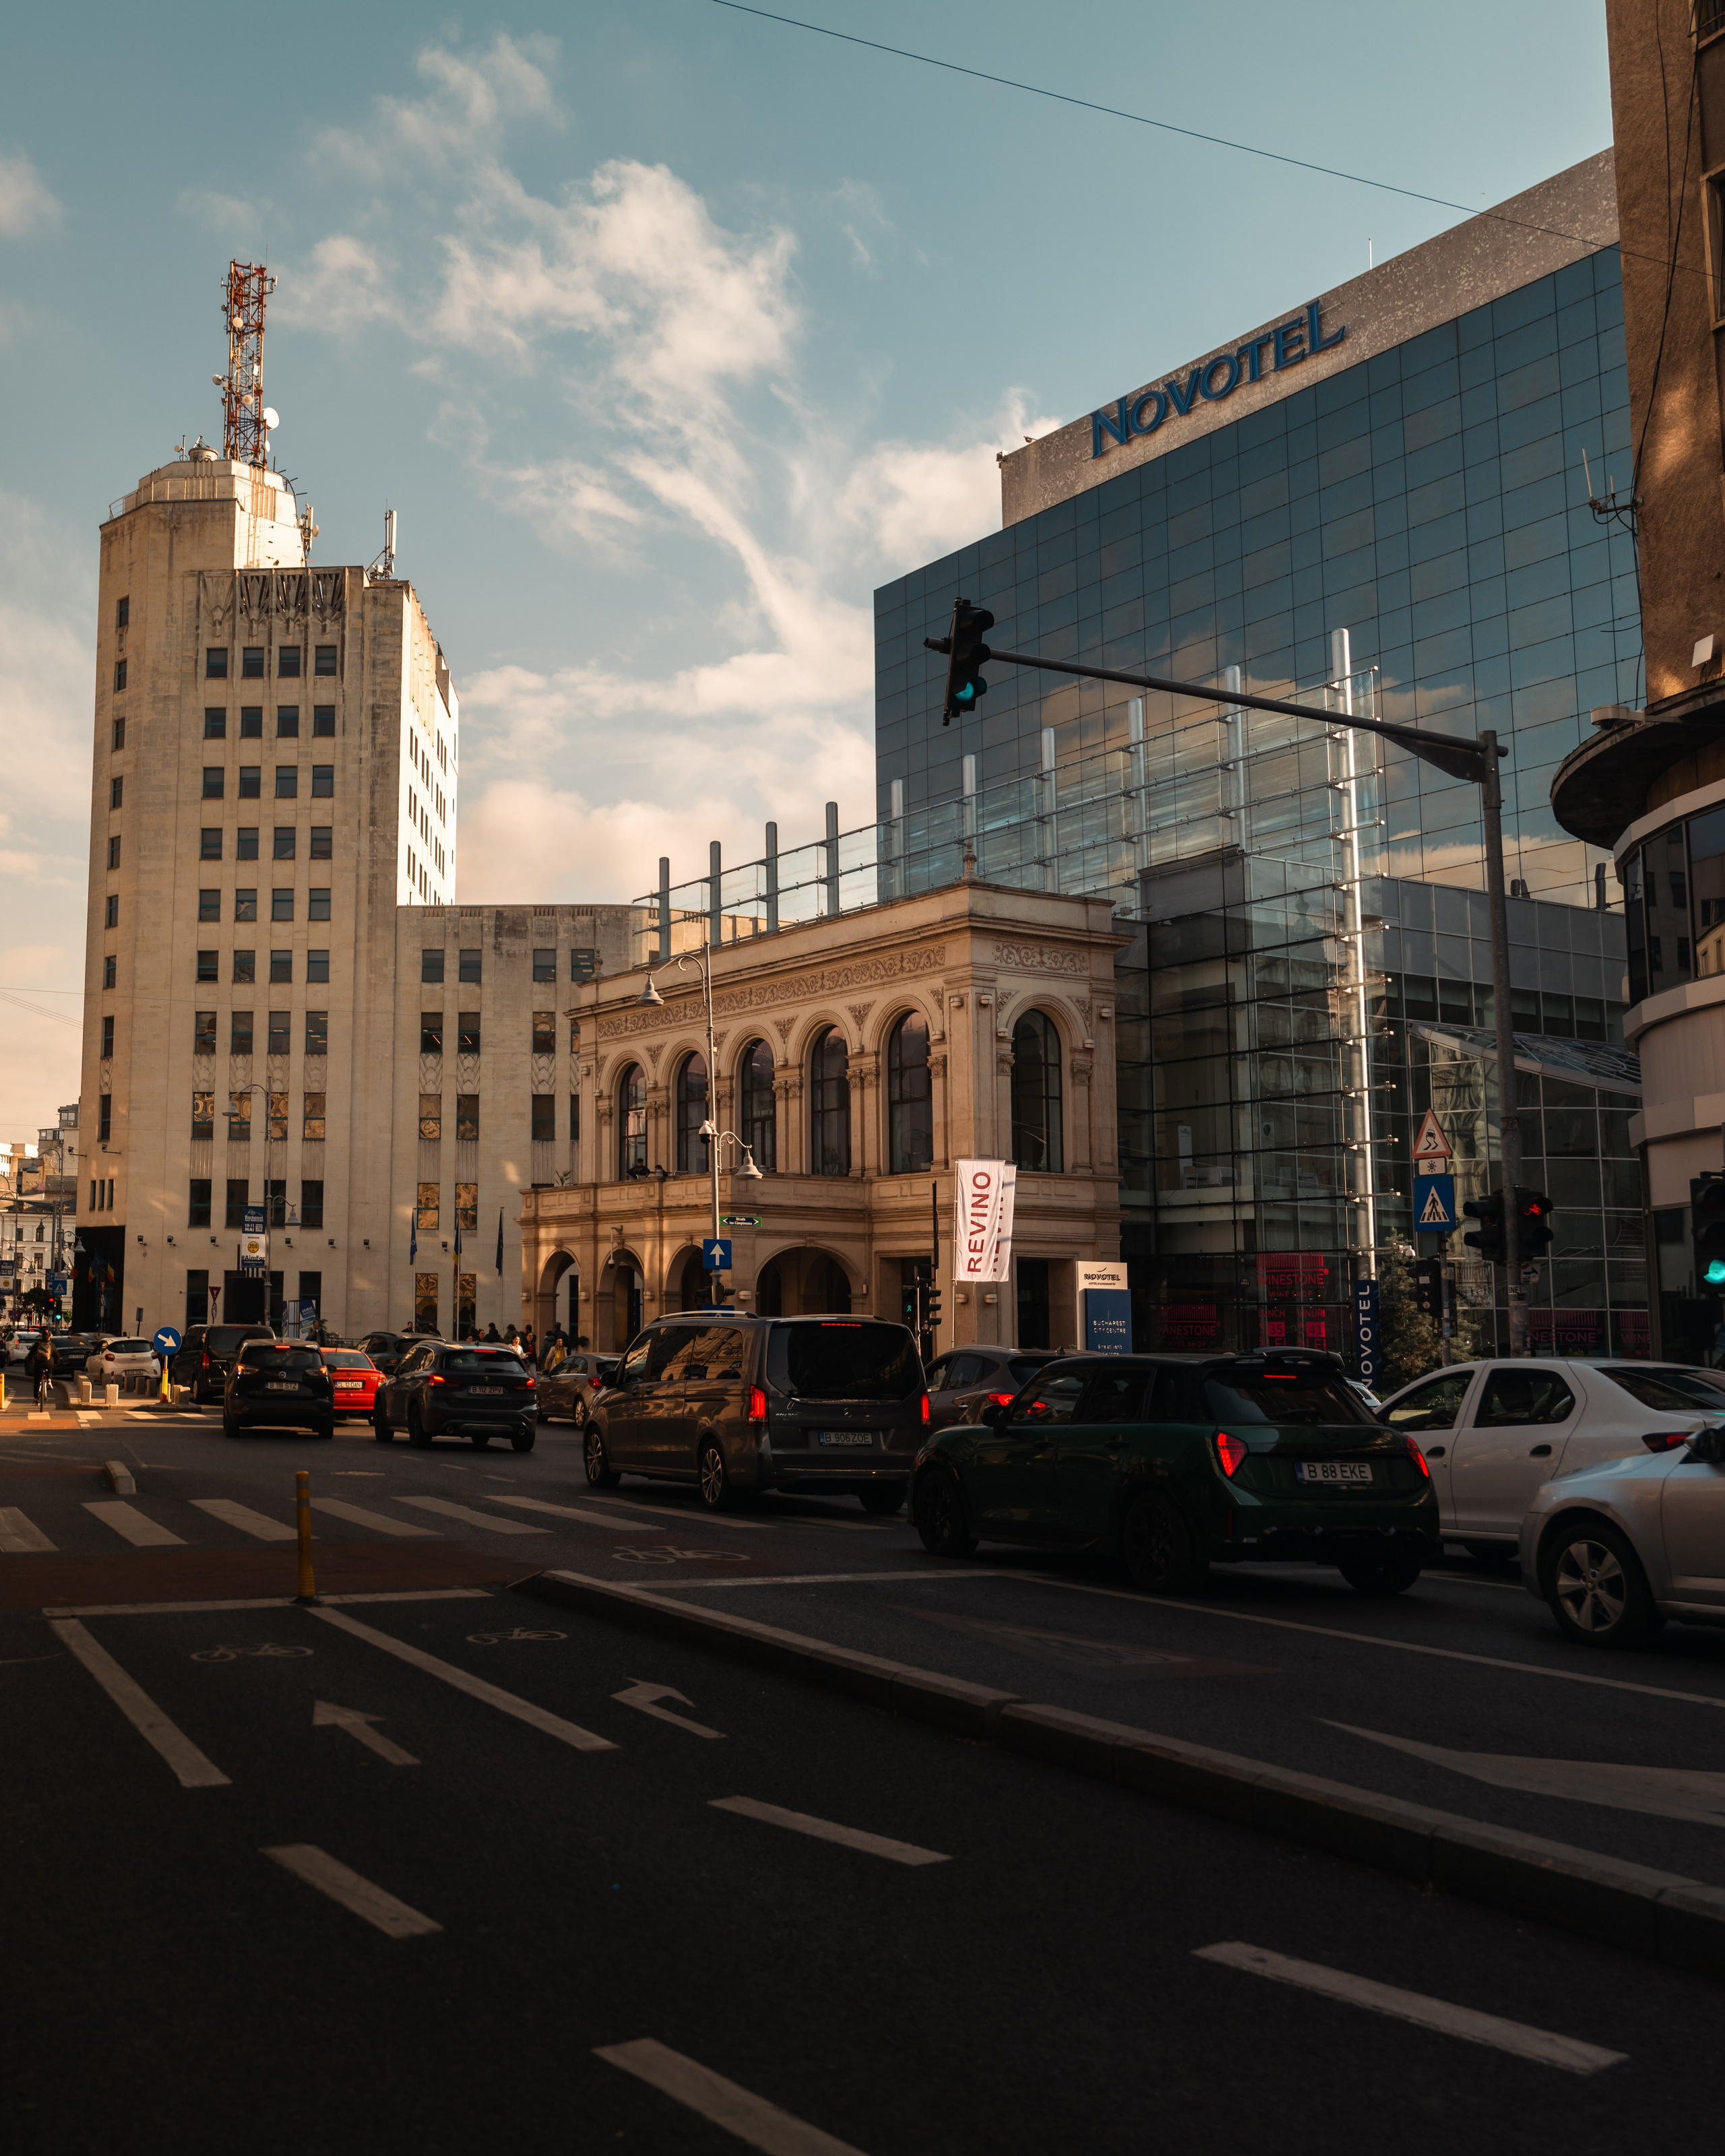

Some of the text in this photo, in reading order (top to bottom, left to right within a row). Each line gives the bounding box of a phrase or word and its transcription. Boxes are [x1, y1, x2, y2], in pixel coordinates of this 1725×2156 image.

[1090, 299, 1346, 459] NOVOTEL
[967, 1172, 991, 1273] REVINO
[1257, 1273, 1325, 1286] WINESTONE
[1258, 1309, 1286, 1318] LUNCH
[1157, 1325, 1217, 1336] WINESTONE
[1269, 1324, 1283, 1335] 35
[1309, 1324, 1323, 1335] 41
[825, 1433, 832, 1442] B
[1307, 1464, 1369, 1479] B 88 EKE
